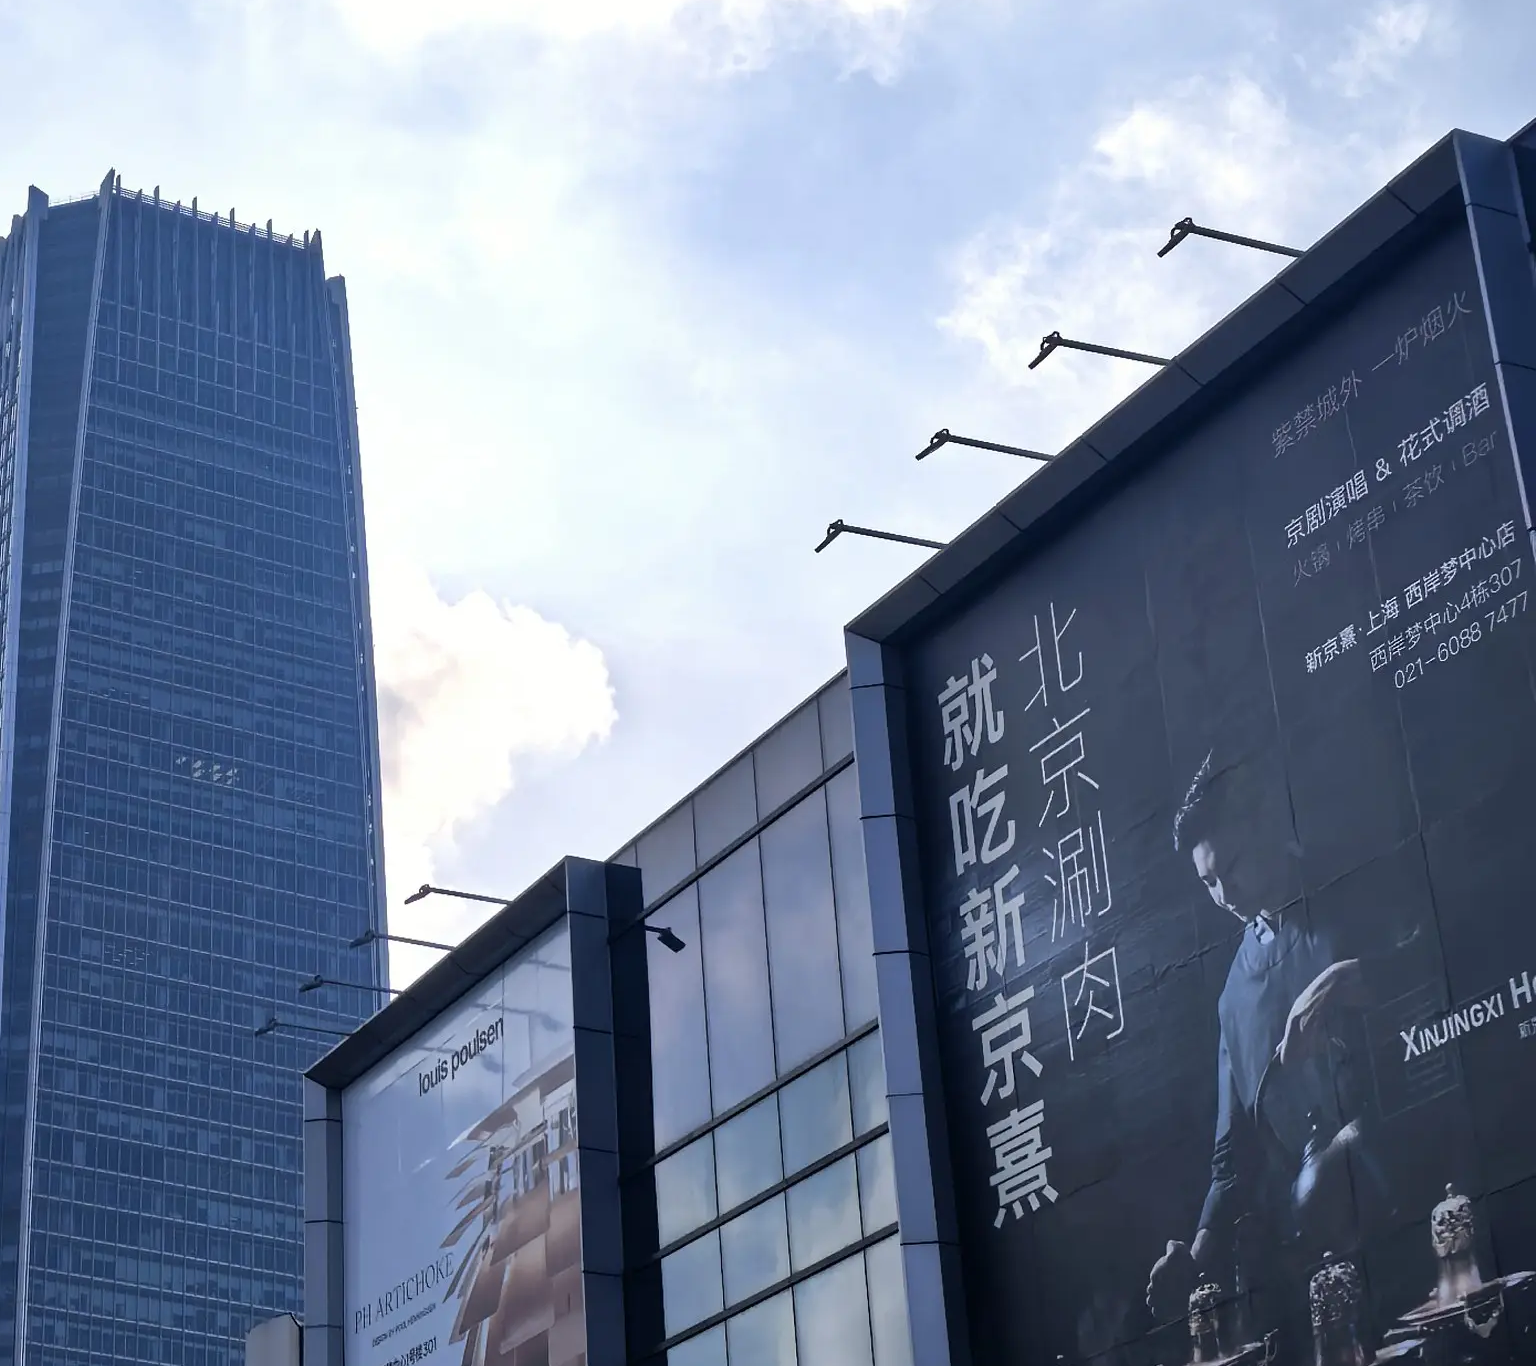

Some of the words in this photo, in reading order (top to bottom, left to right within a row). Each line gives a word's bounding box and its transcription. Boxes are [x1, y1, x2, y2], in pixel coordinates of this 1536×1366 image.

[1271, 370, 1362, 458] 紫禁城外
[1372, 291, 1472, 371] 一炉烟火
[1284, 470, 1368, 548] 京剧演唱
[1375, 458, 1392, 482] &
[1398, 383, 1490, 466] 花式调酒
[1462, 431, 1498, 466] Bar
[1404, 520, 1515, 609] 西岸梦中心店
[1369, 558, 1521, 672] 西岸梦中心4栋307
[1394, 622, 1482, 688] 021-6088
[1485, 591, 1528, 632] 7477
[1019, 602, 1125, 1061] 北京涮肉
[938, 653, 1059, 1228] 就吃新京熹
[419, 1058, 449, 1097] louis
[451, 1017, 504, 1080] poulsen
[1400, 993, 1504, 1062] XINJINGXI
[355, 1303, 372, 1334] PH
[375, 1252, 455, 1322] ARTICHOKE
